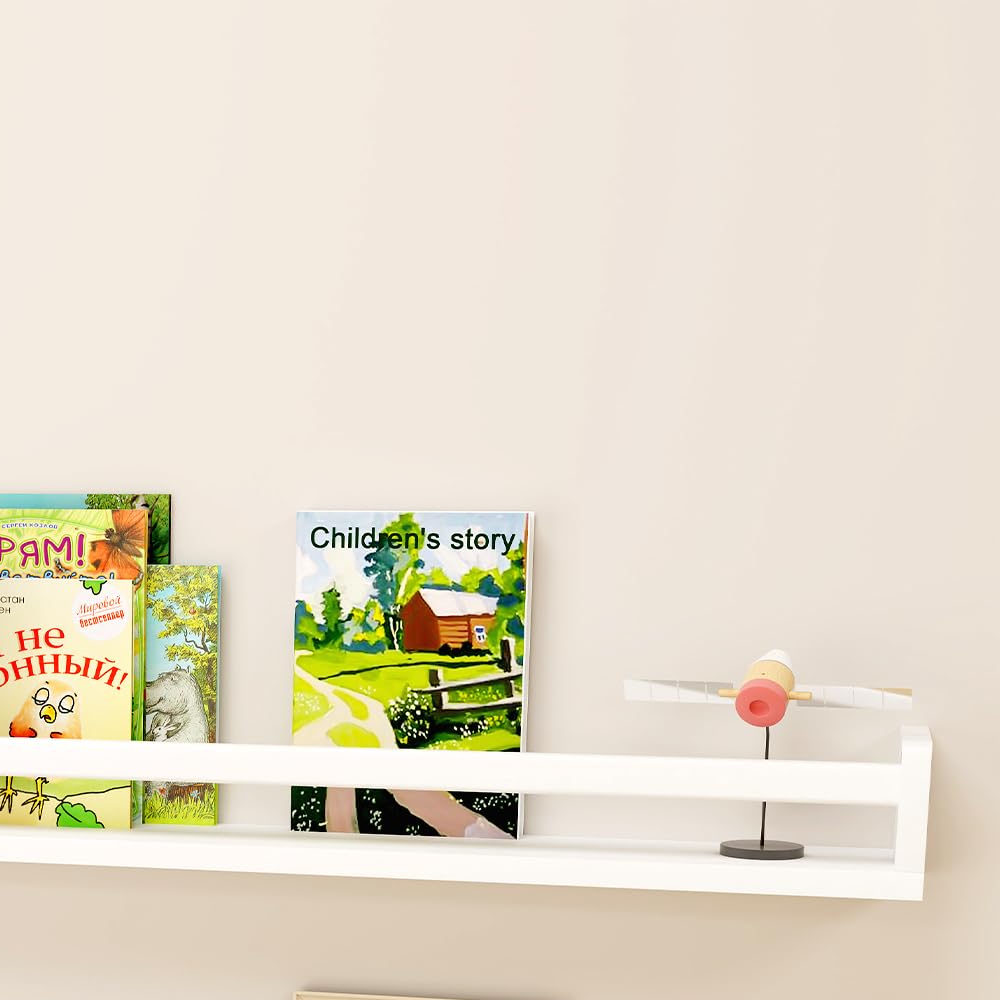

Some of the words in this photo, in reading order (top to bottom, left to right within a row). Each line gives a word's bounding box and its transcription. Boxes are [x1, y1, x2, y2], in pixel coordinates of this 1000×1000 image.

[310, 526, 441, 549] Children's
[450, 528, 516, 555] story
[76, 594, 121, 616] Мировой
[15, 627, 65, 652] не
